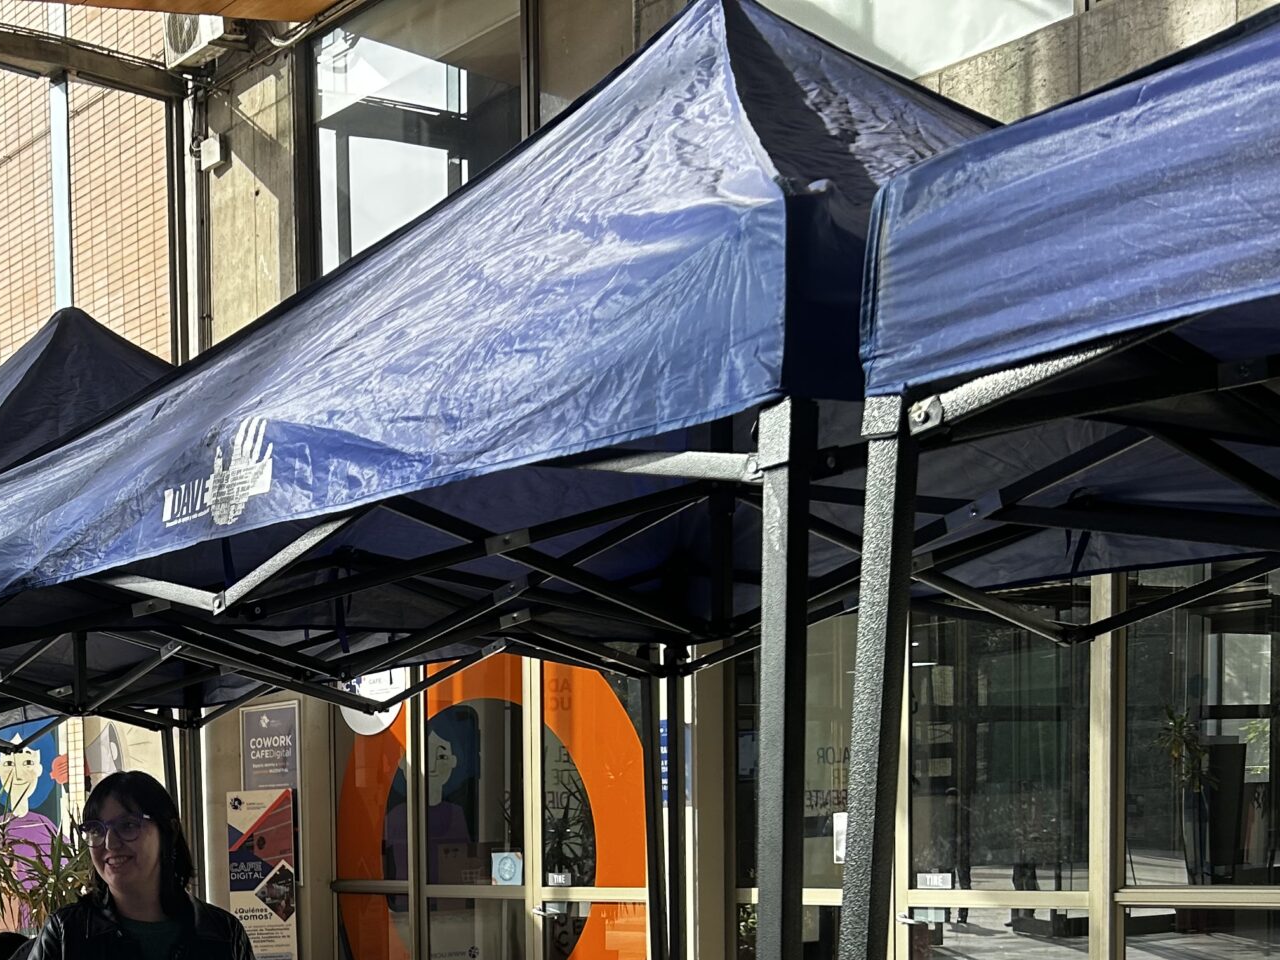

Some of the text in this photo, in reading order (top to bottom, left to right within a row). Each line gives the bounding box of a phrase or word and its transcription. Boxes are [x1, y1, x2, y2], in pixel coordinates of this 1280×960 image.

[250, 735, 292, 749] COWORK
[230, 871, 265, 880] DIGITAL
[925, 875, 943, 887] TIRE
[234, 907, 268, 915] ¿Quiénes
[238, 913, 273, 922] somos?
